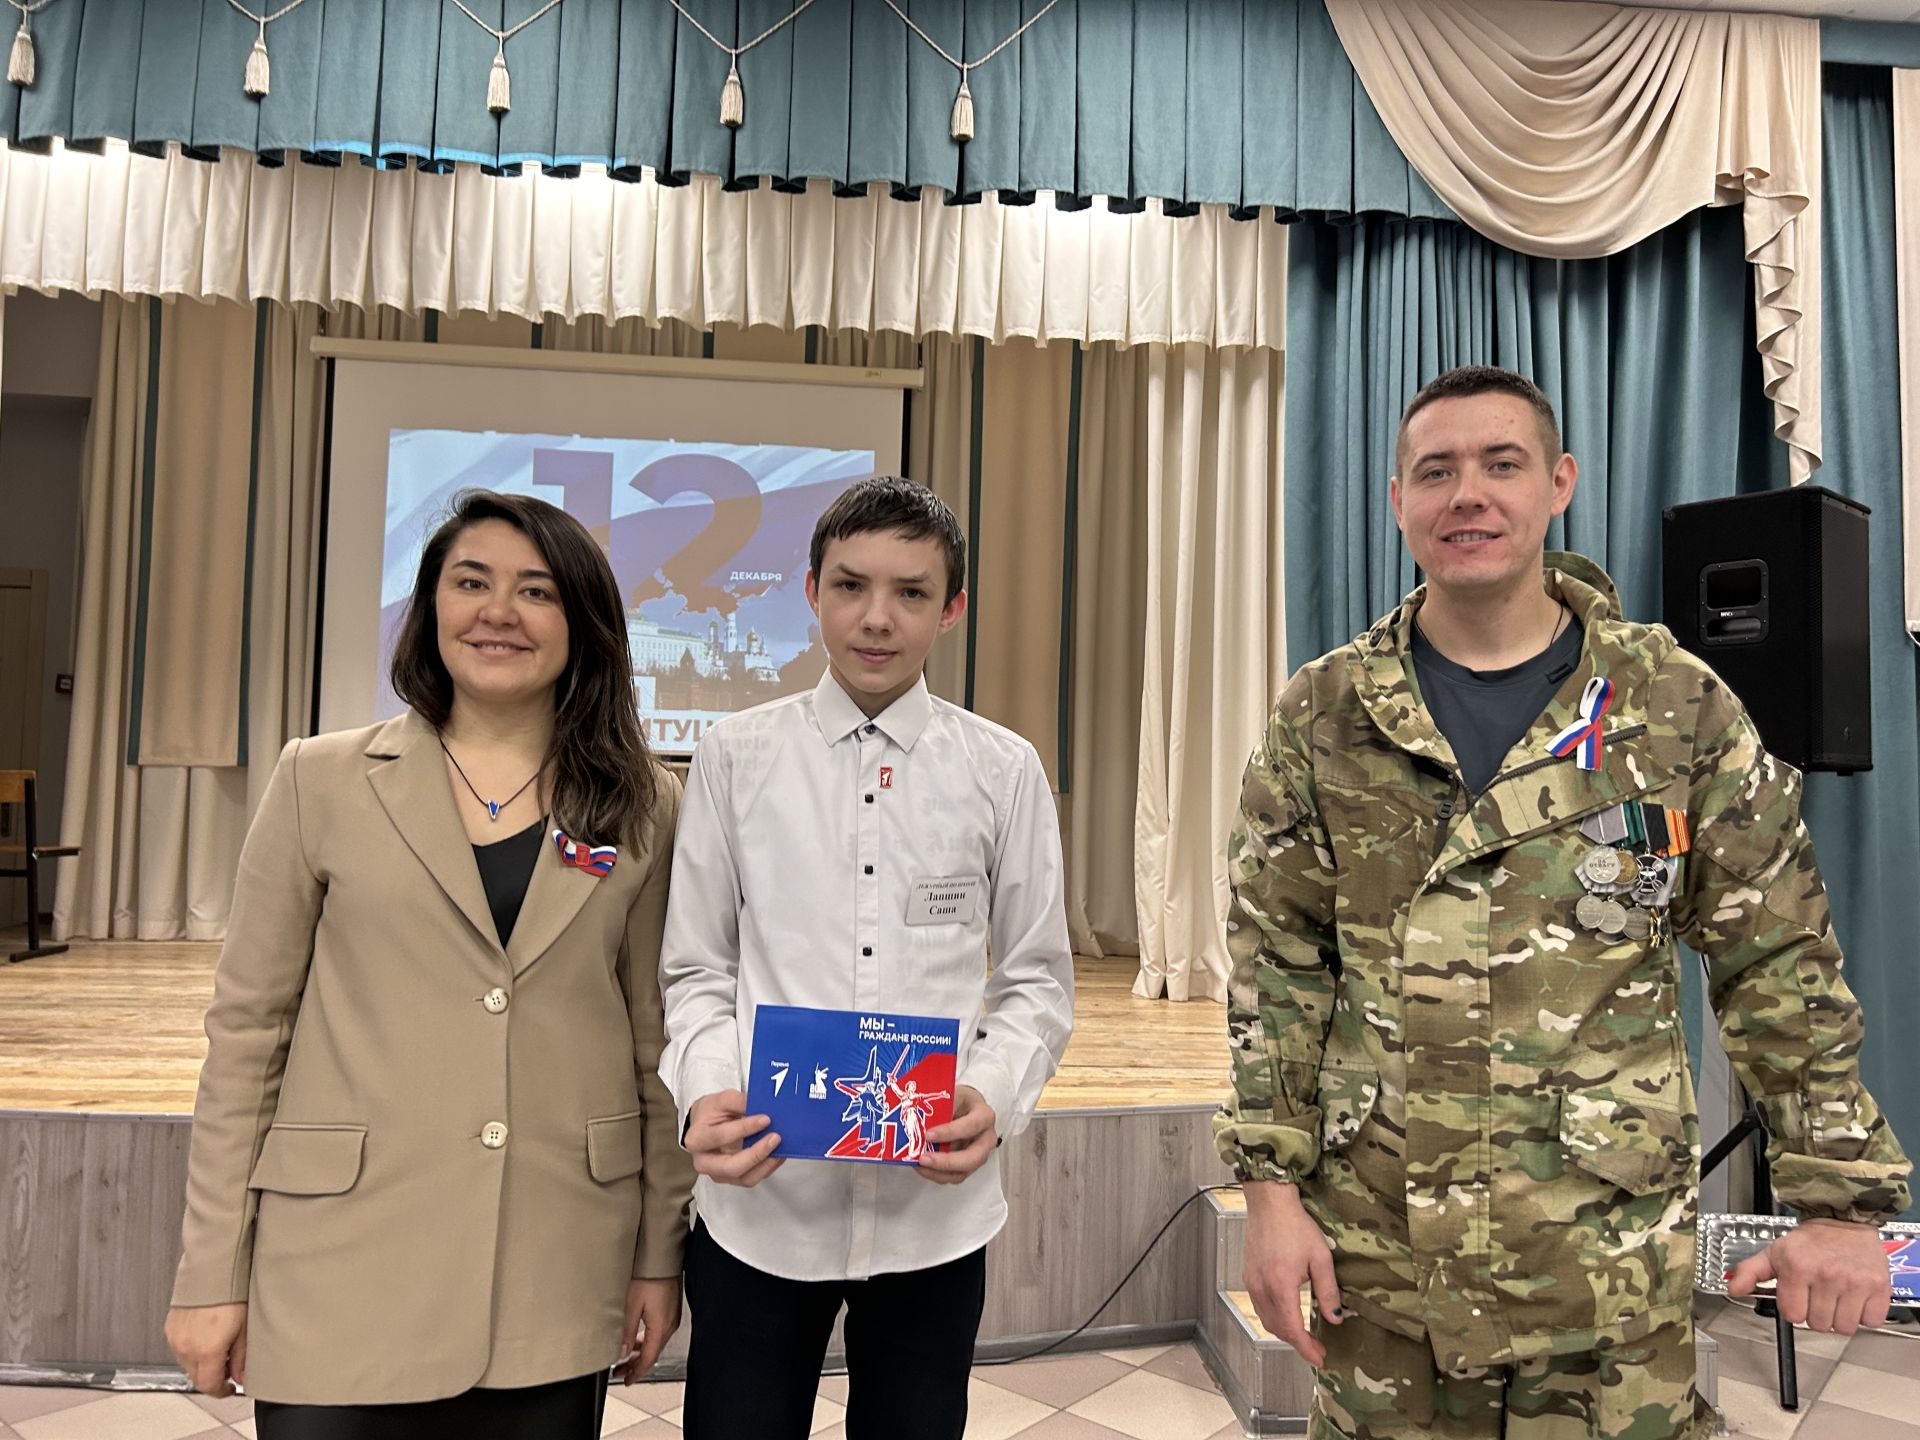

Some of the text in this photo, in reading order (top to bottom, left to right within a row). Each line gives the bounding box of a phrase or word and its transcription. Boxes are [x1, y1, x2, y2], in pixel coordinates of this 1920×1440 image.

[532, 448, 762, 609] 12
[730, 571, 782, 582] ДЕКАБРЯ
[929, 905, 957, 915] Саша
[859, 1017, 885, 1031] МЫ
[859, 1031, 952, 1045] ГРАЖДАНЕ РОССИИ!
